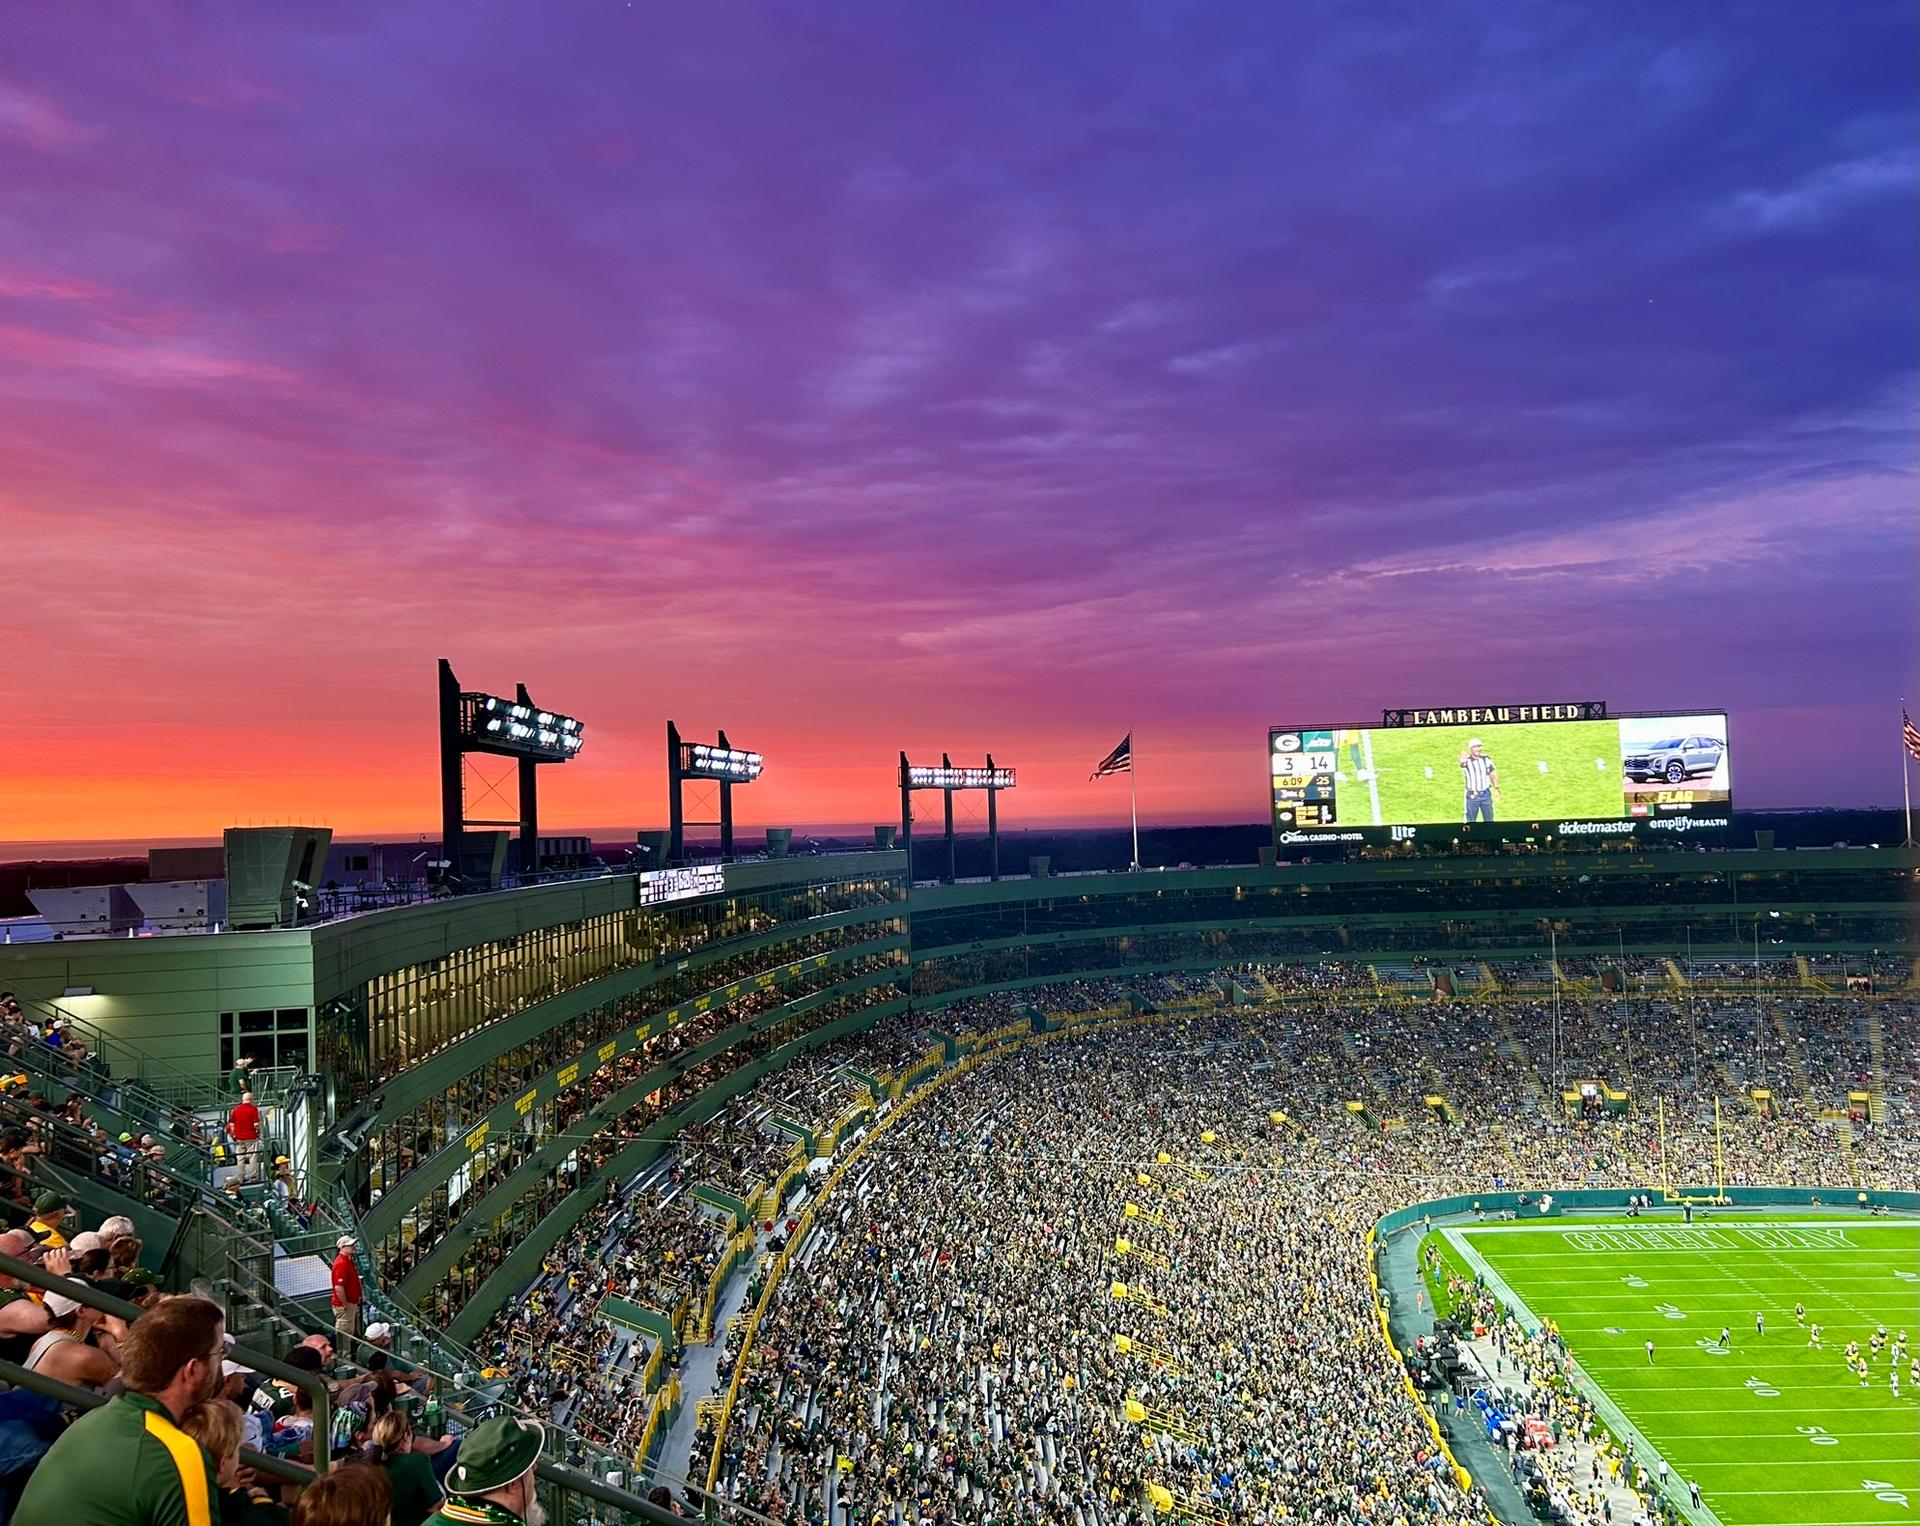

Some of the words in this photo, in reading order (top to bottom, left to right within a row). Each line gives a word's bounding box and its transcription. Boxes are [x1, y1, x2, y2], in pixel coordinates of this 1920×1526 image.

[1413, 707, 1510, 725] LAMBEAU
[1519, 705, 1579, 721] FIELD
[1284, 757, 1294, 771] 3
[1310, 756, 1329, 770] 14
[1558, 820, 1637, 834] ticketmaster
[1561, 1229, 1740, 1251] GREEN
[1735, 1229, 1859, 1249] BAY
[1654, 1303, 1688, 1318] 20
[1695, 1337, 1731, 1355] 30
[1743, 1377, 1782, 1396] 40
[1795, 1426, 1840, 1445] 50
[1861, 1479, 1909, 1503] 40
